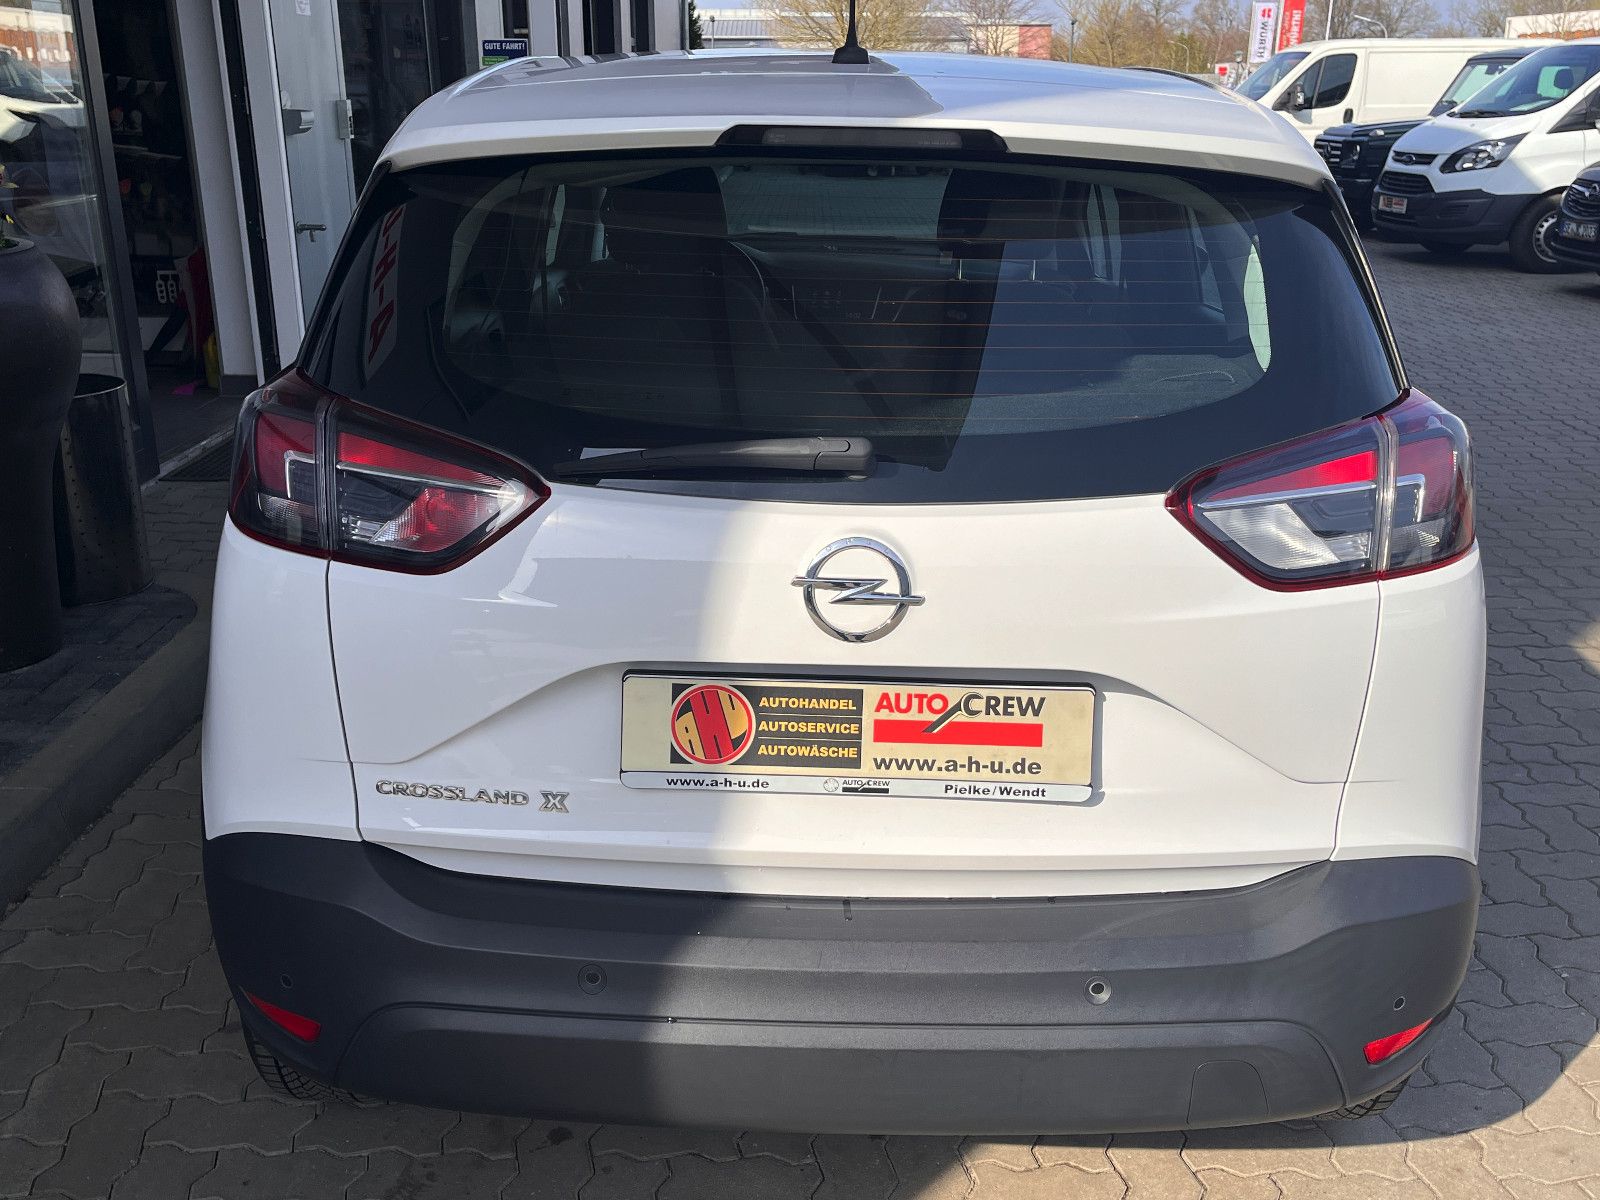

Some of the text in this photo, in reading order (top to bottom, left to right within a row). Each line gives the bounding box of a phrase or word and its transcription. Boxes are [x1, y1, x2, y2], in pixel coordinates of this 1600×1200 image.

[484, 42, 525, 50] GUTE FAHRT!
[758, 696, 857, 710] AUTOHANDEL
[874, 691, 1046, 717] AUTO CREW
[758, 720, 860, 734] AUTOSERVICE
[757, 744, 858, 758] AUTOWÄSCHE
[872, 755, 1042, 775] www.a-h-u.de
[665, 777, 770, 789] www.a-h-u.de
[866, 779, 891, 787] CREW
[375, 779, 571, 814] CROSSLAND X
[943, 784, 1047, 798] Pielke/Wendt
